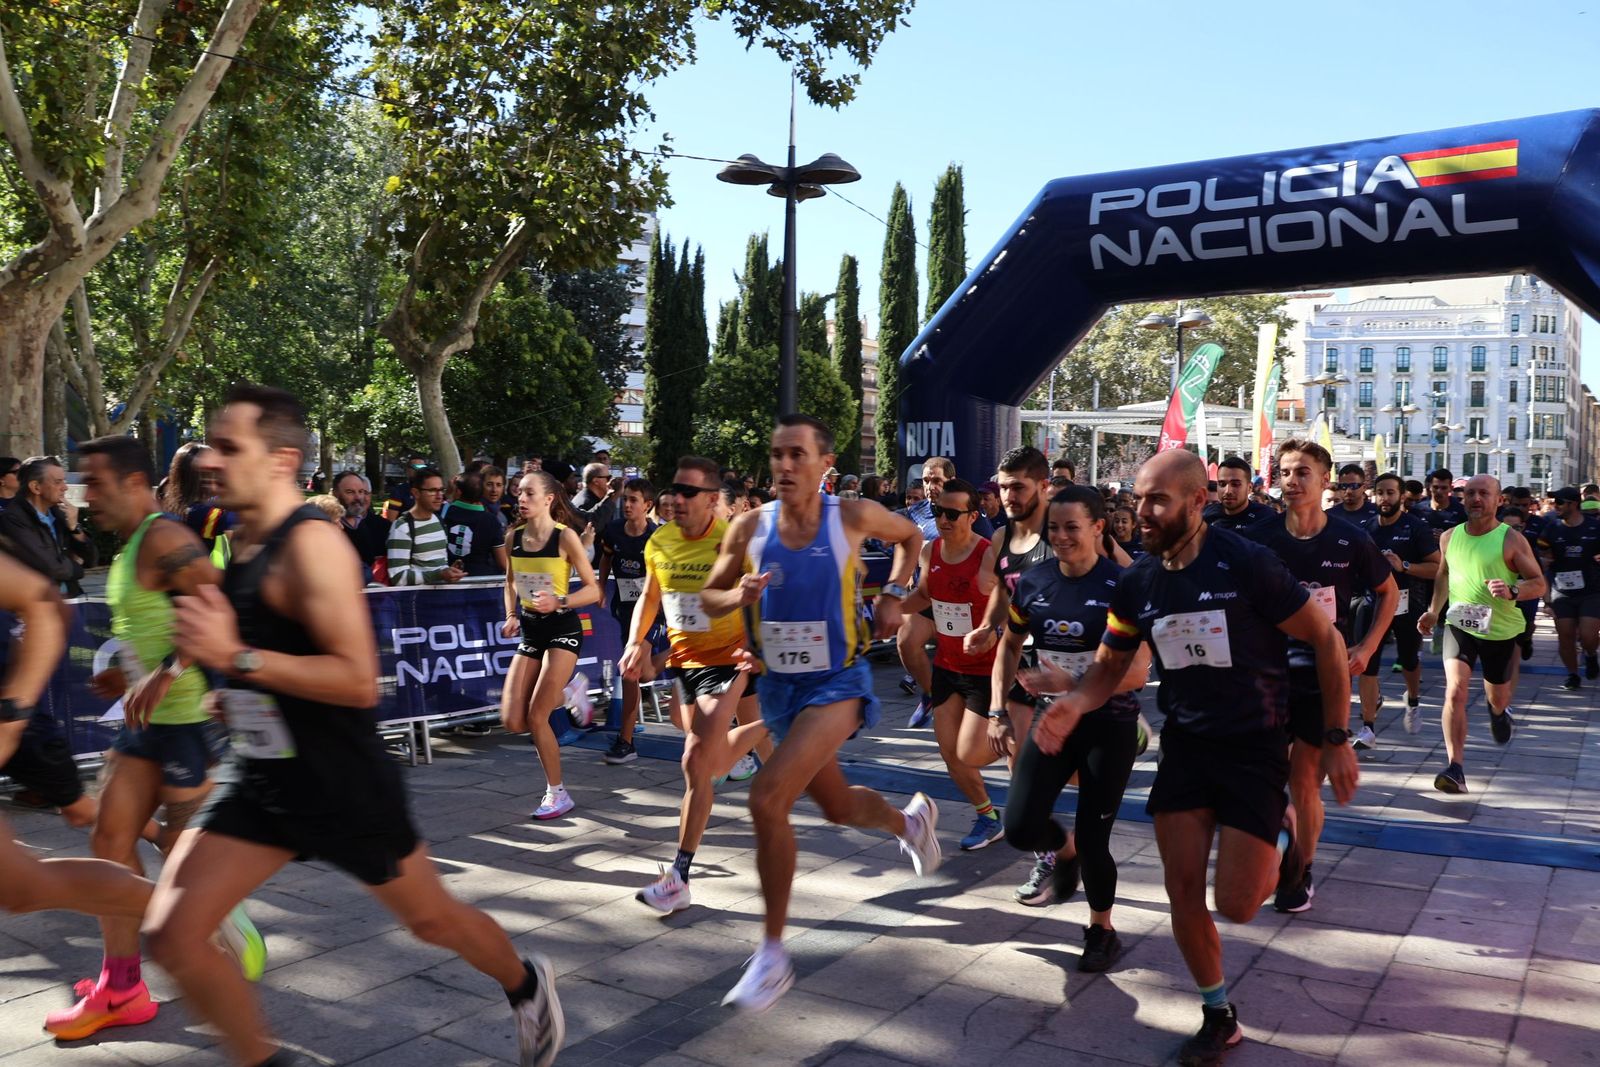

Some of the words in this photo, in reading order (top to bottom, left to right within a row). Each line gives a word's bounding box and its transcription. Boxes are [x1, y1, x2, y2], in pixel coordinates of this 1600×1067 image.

[1089, 193, 1519, 270] NACIONAL
[906, 421, 956, 457] RUTA
[629, 590, 643, 598] 20
[946, 621, 954, 631] 6
[1043, 618, 1085, 637] 200
[1459, 618, 1480, 629] 195
[391, 619, 526, 654] POLIC
[1184, 643, 1206, 657] 16
[778, 651, 811, 665] 176
